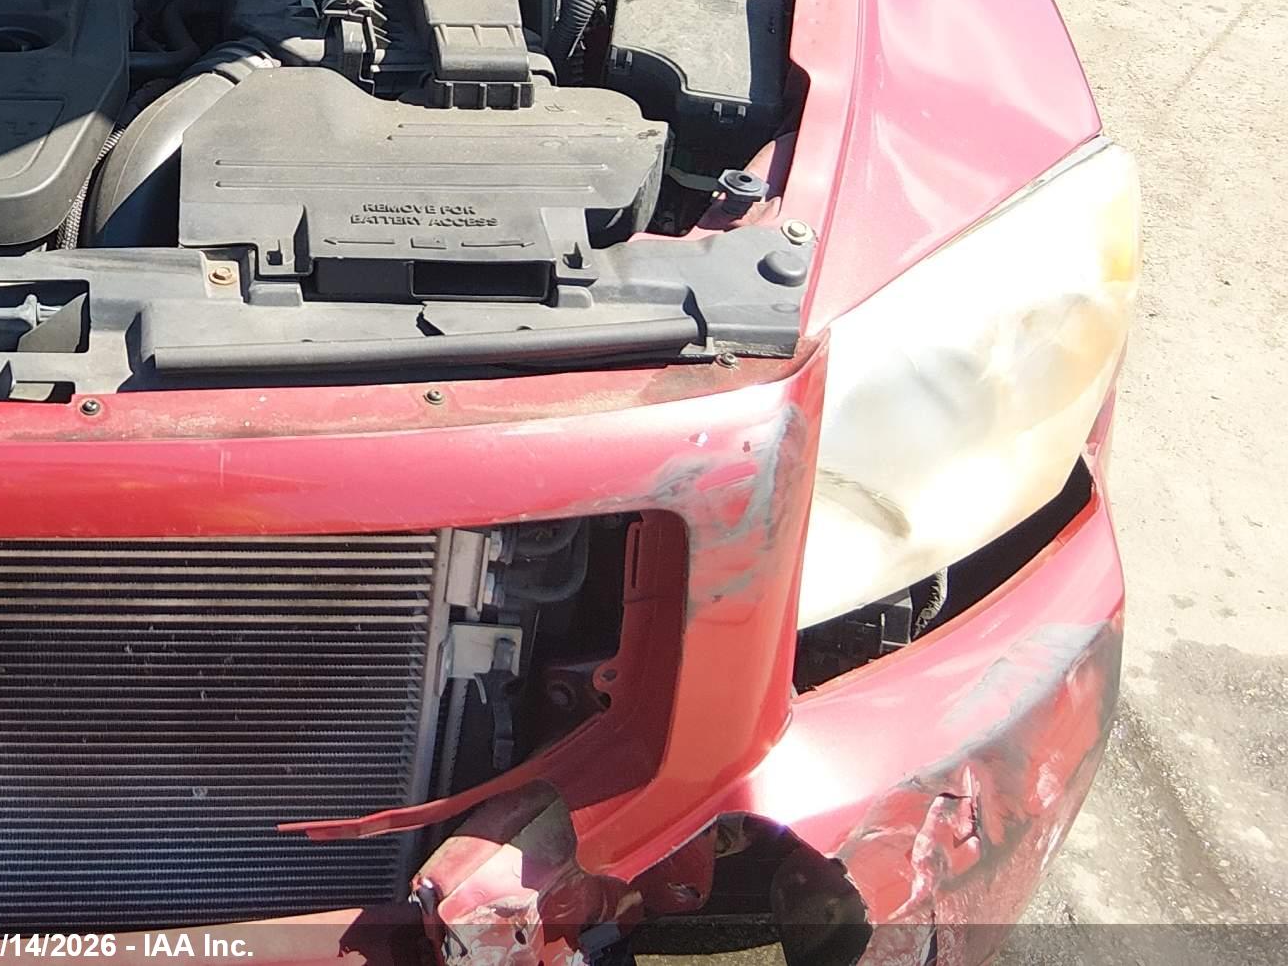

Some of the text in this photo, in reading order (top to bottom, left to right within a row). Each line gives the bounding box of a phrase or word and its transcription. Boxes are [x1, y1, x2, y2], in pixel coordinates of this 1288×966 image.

[362, 203, 476, 215] REMOVE FOR
[350, 215, 499, 227] BATTERY ACCESS
